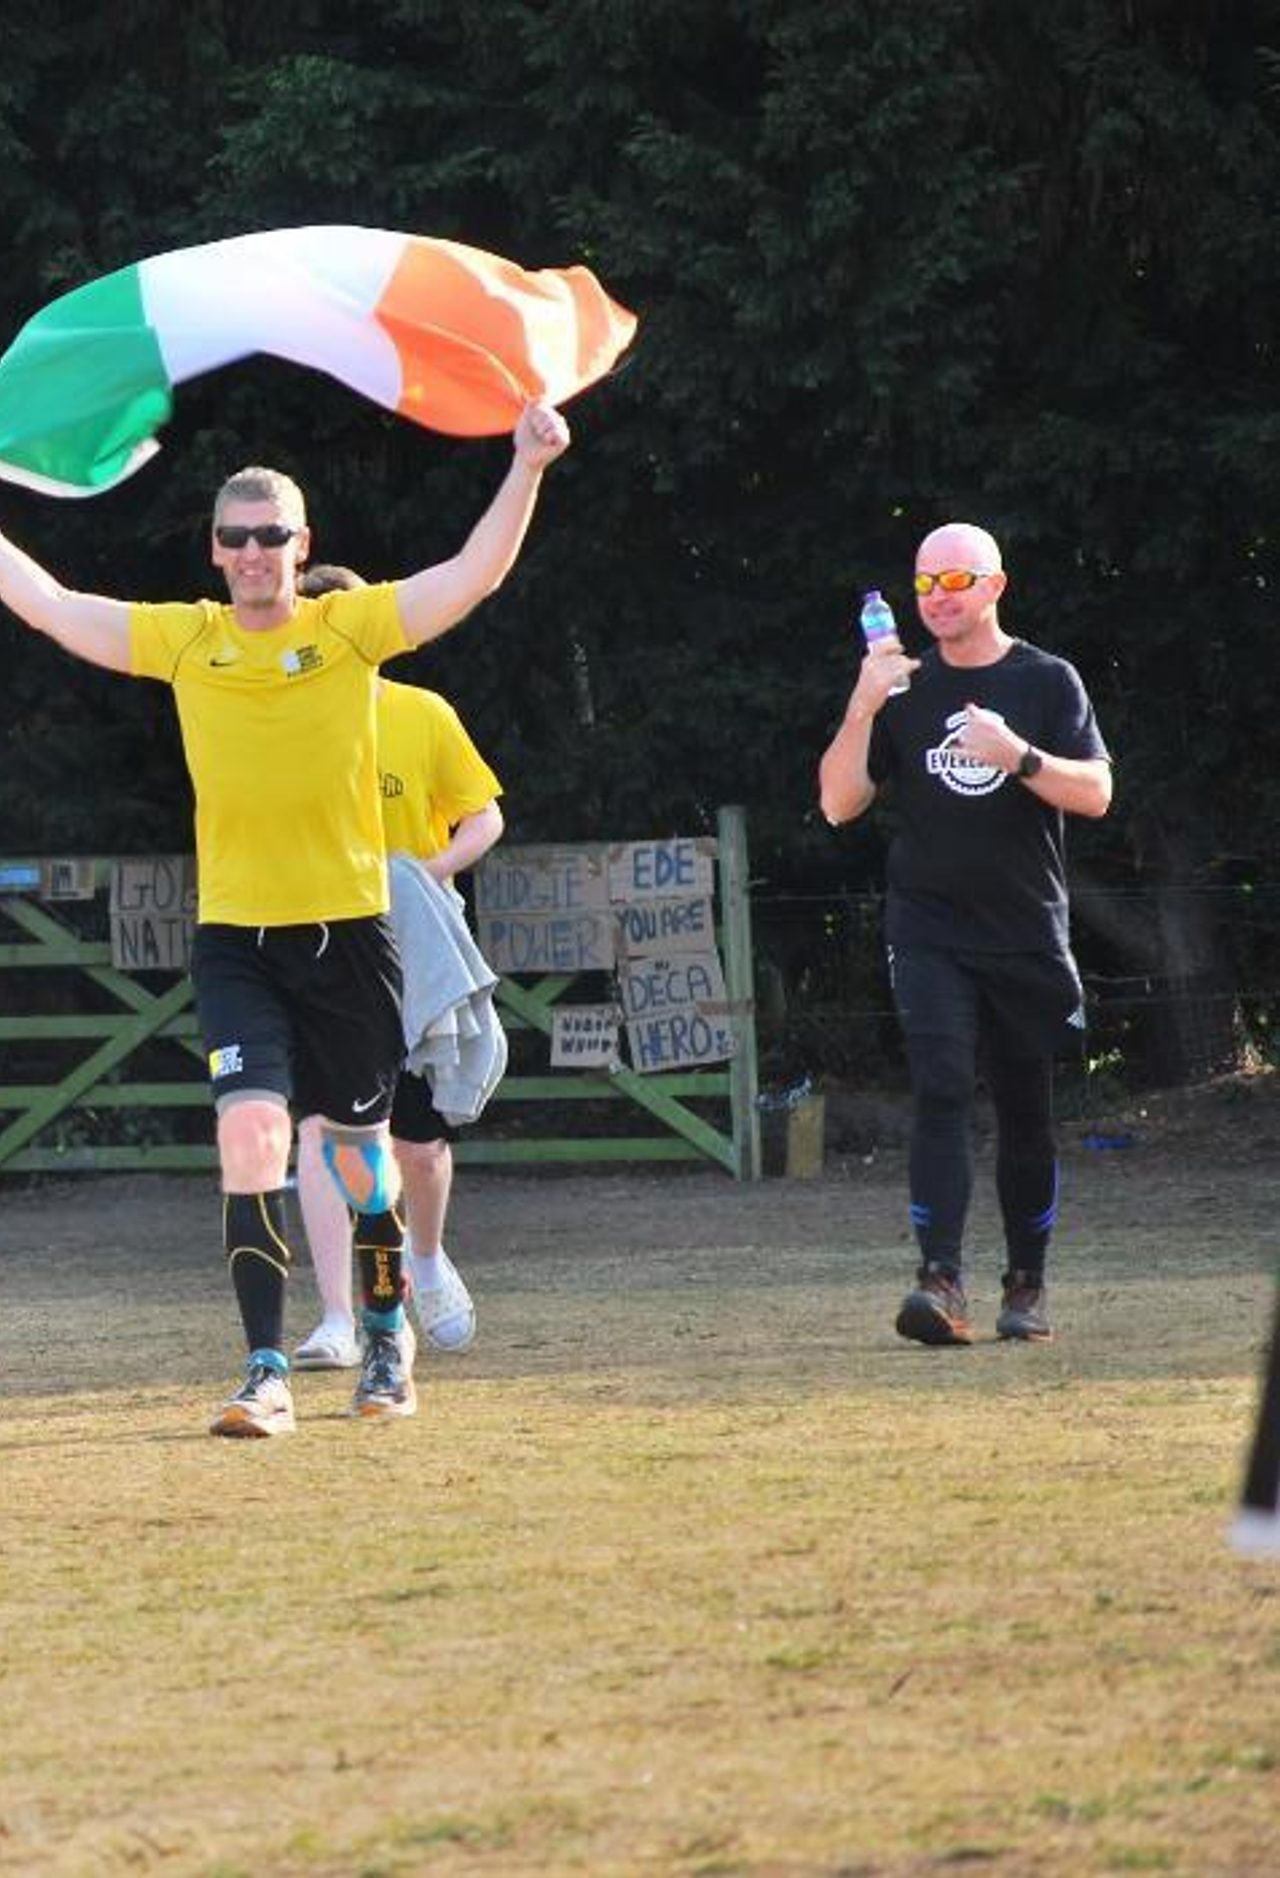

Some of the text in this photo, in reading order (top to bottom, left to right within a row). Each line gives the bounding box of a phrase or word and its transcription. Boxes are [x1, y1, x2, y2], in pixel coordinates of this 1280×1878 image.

[633, 843, 696, 890] EDE
[489, 918, 604, 968] POWER
[616, 897, 705, 943] YOU ARE
[627, 964, 713, 1014] DECA
[636, 1014, 713, 1068] HERO
